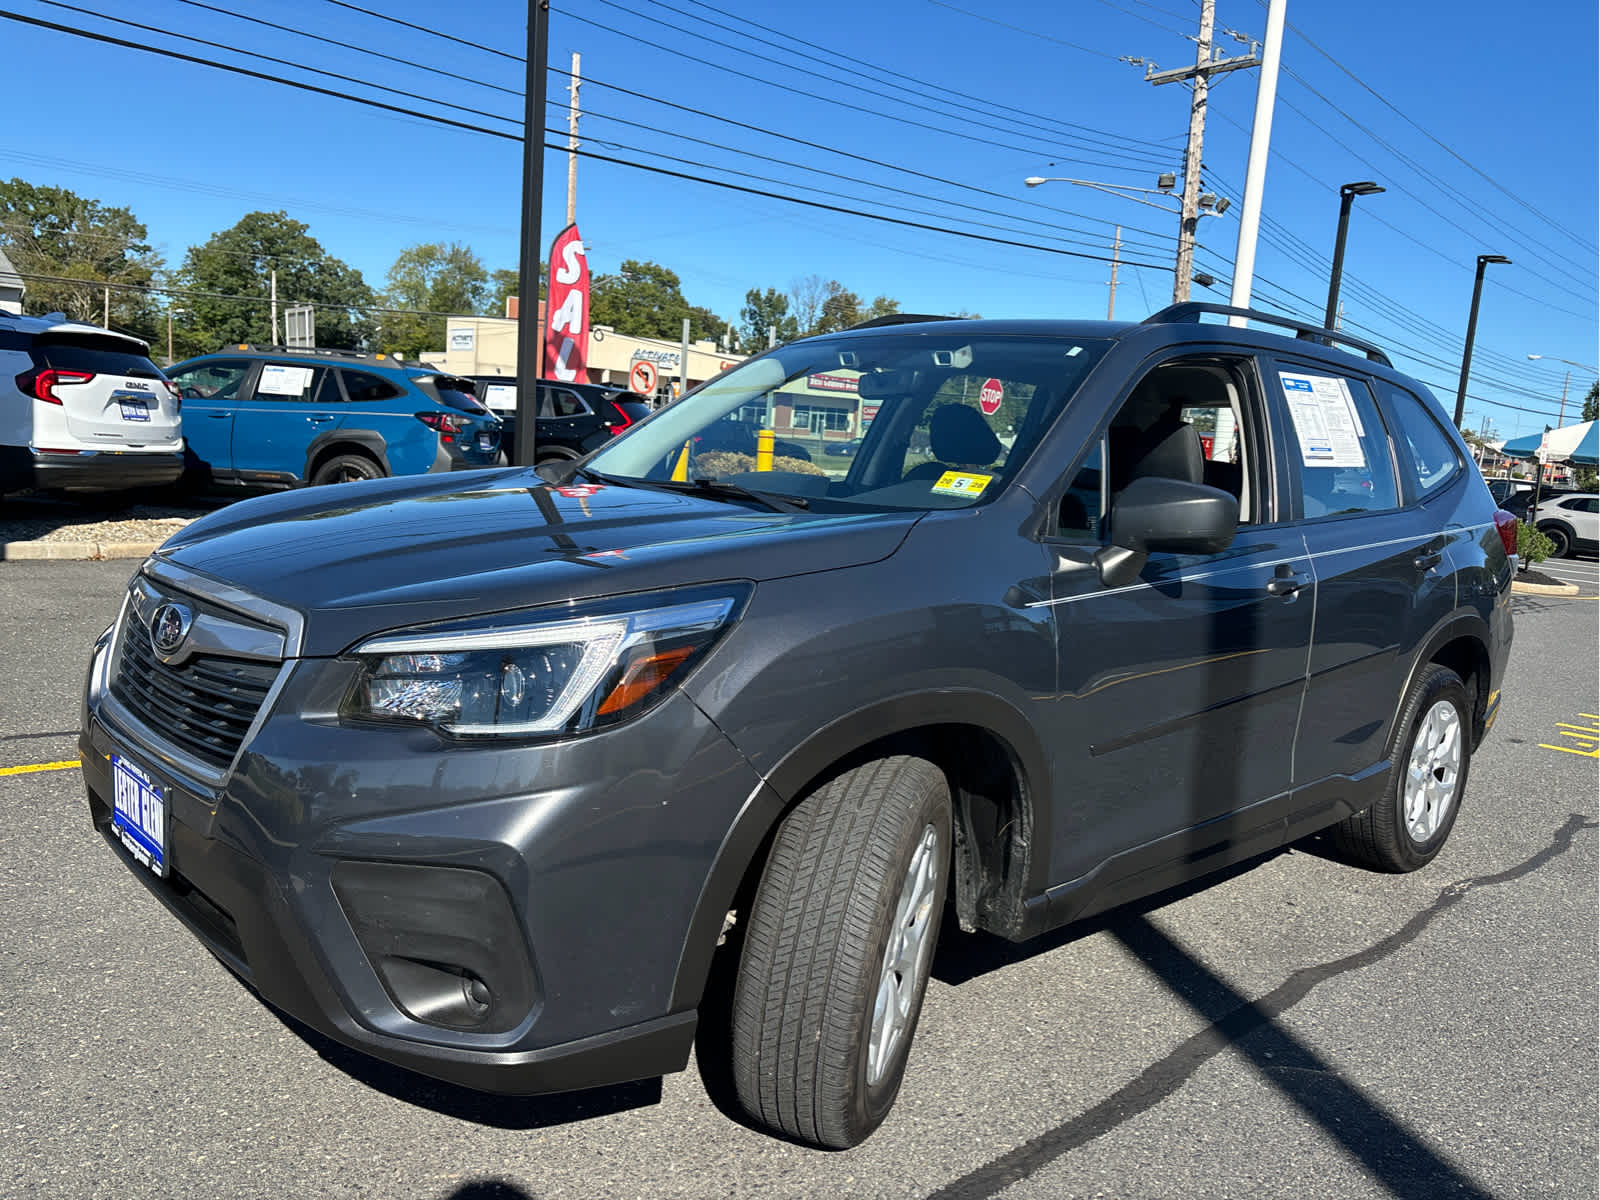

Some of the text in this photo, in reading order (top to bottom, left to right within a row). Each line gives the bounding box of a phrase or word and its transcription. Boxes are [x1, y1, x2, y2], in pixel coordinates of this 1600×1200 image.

[552, 240, 585, 382] SAL
[125, 382, 149, 391] GMC
[981, 388, 1001, 404] STOP
[953, 479, 966, 488] 5
